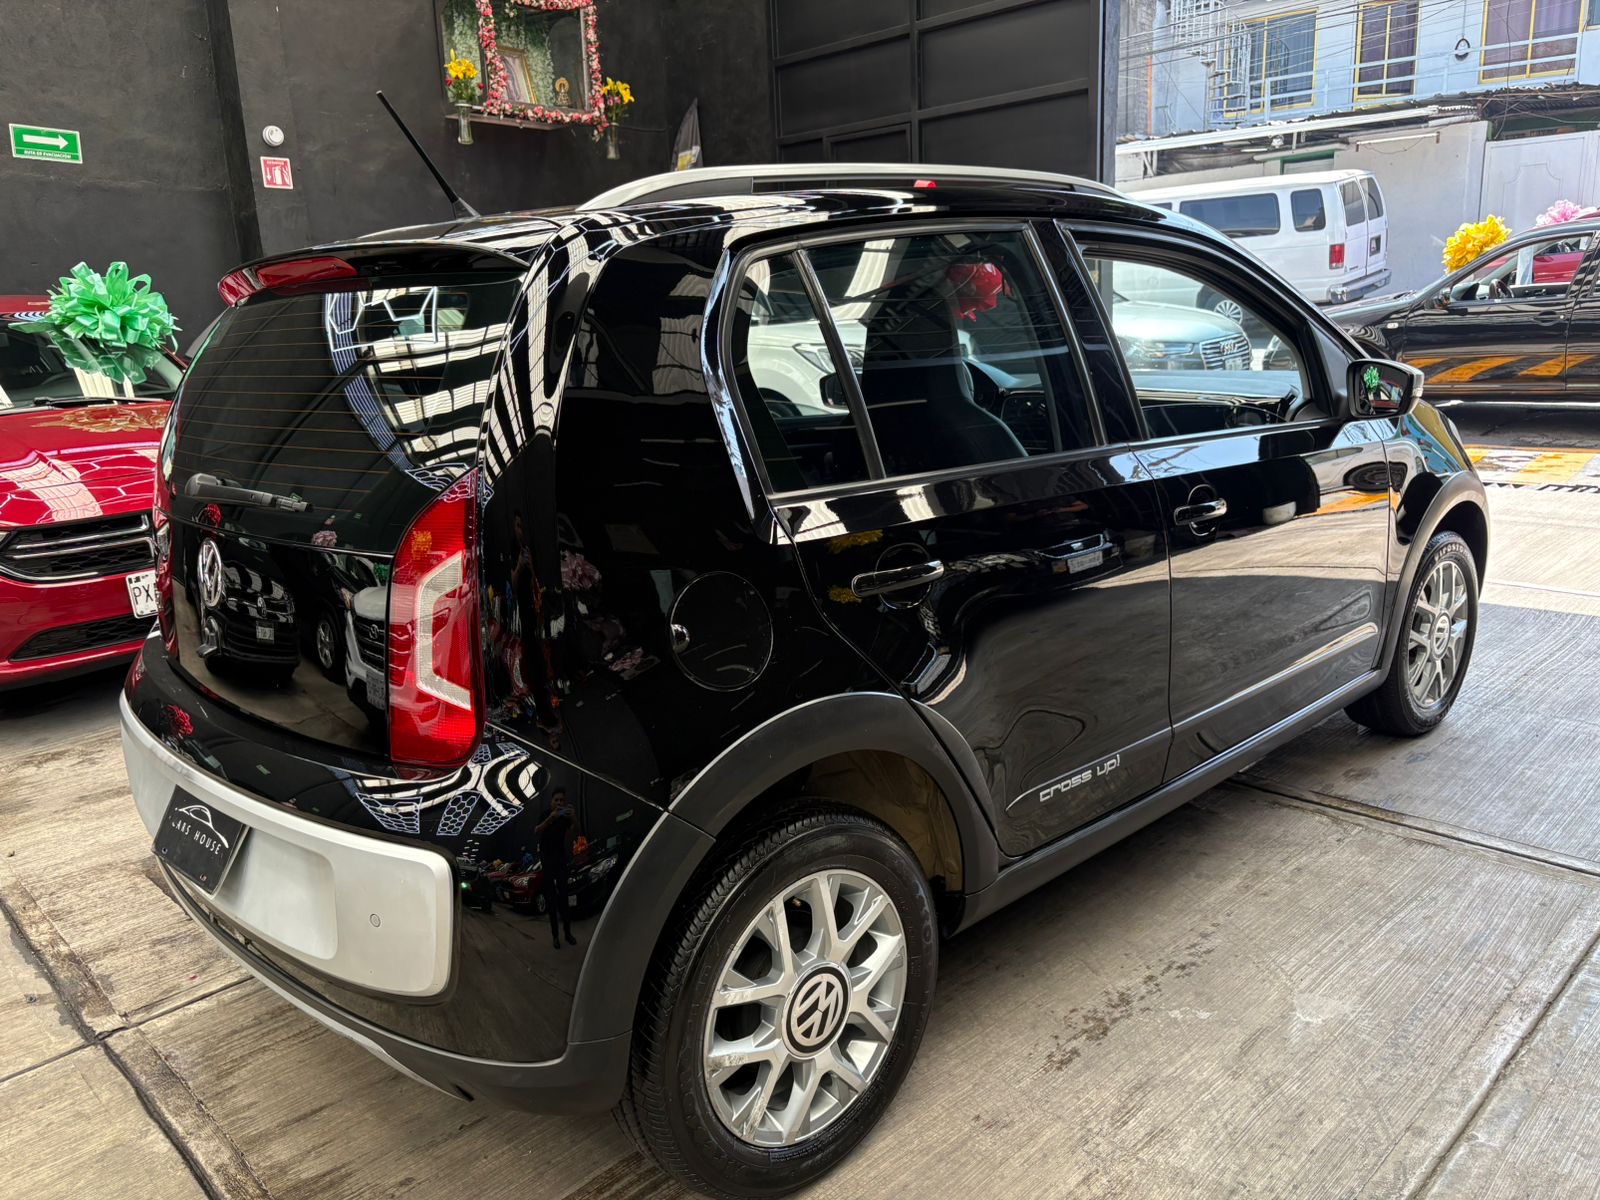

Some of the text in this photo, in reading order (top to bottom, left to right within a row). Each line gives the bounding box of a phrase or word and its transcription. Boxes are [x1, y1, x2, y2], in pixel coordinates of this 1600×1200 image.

[132, 582, 157, 605] PX
[1039, 753, 1121, 803] cross up!
[193, 829, 222, 855] HOUSE
